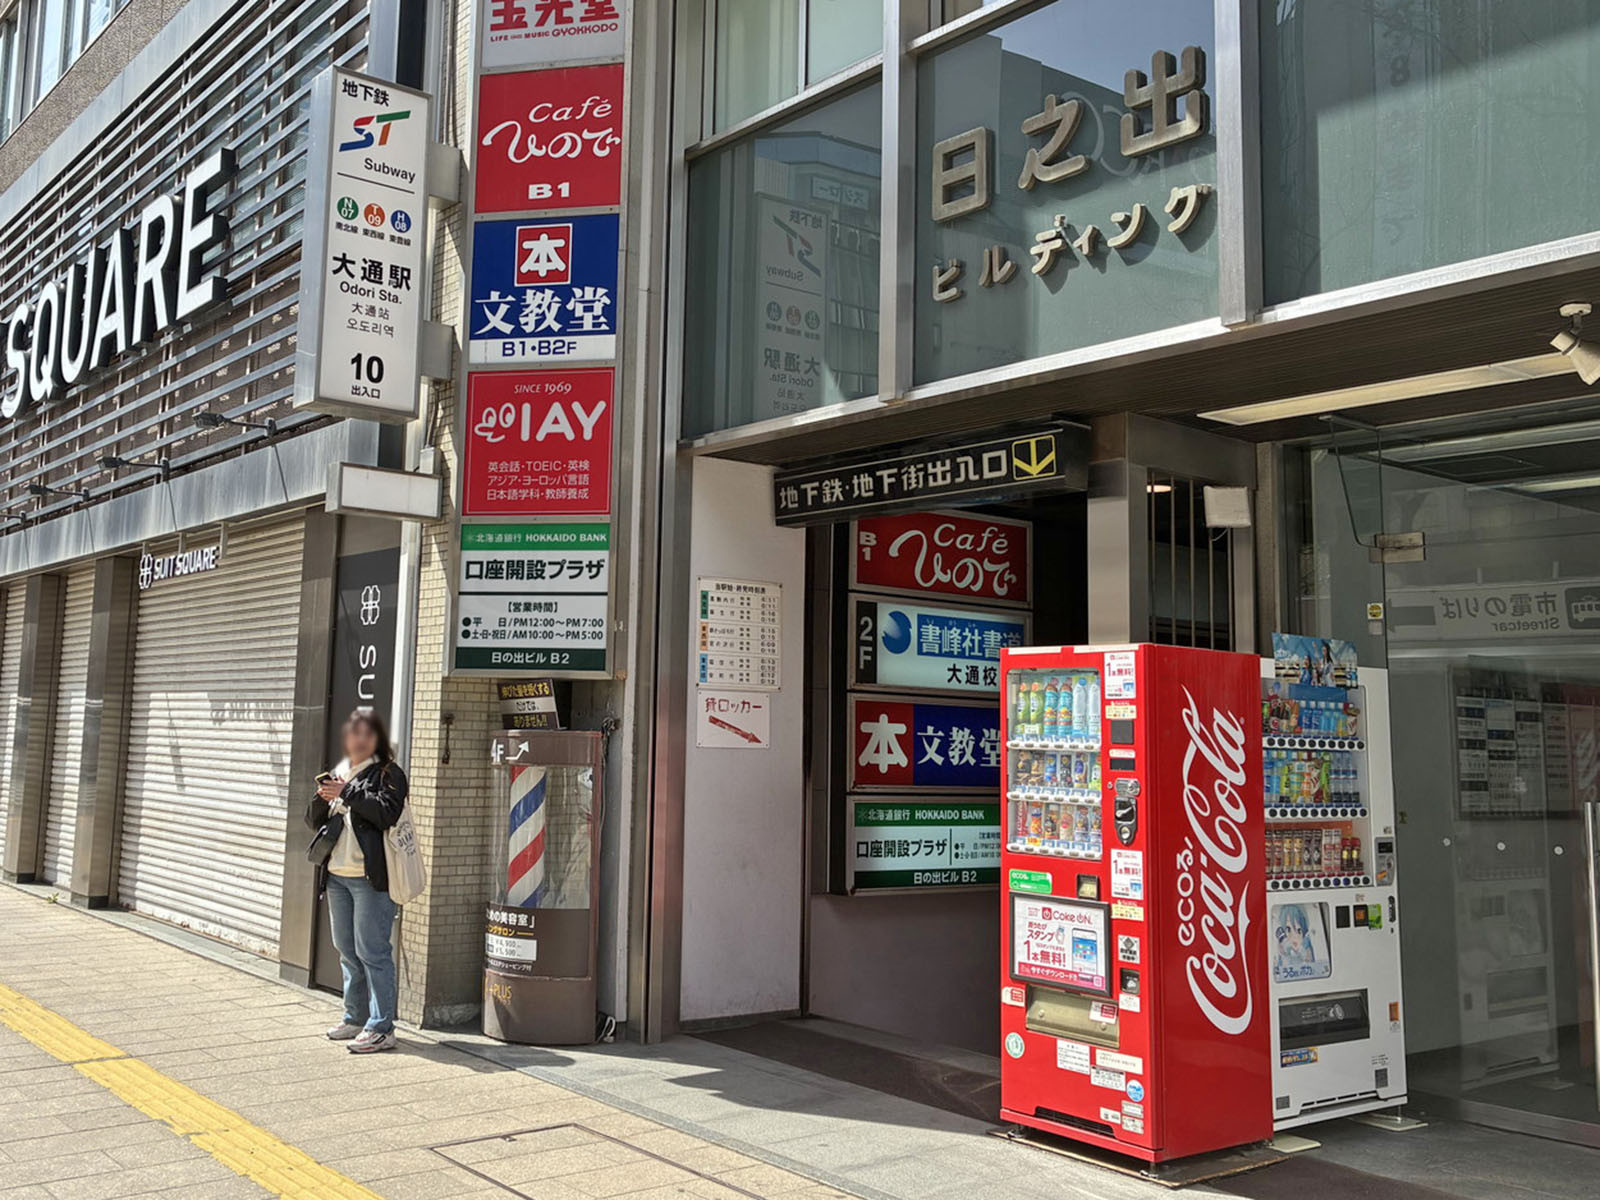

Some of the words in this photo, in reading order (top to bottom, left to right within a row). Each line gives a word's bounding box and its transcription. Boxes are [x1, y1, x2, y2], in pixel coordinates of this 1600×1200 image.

[524, 31, 550, 39] MUSIC
[552, 22, 618, 37] GYOKKODO
[341, 78, 390, 107] 地下鉄
[528, 96, 613, 123] Café
[482, 120, 621, 163] ひので
[932, 46, 1210, 221] 日之出
[364, 157, 416, 184] Subway
[528, 182, 570, 200] B1
[520, 233, 566, 277] 本
[932, 184, 1212, 302] ビルディング
[1, 148, 230, 419] SQUARE
[331, 252, 412, 291] 大通駅
[339, 280, 376, 299] Odori
[378, 287, 403, 305] Sta.
[351, 302, 390, 320] 大通站
[474, 286, 612, 335] 文教堂
[346, 317, 395, 338] 오도리역
[350, 353, 384, 384] 10
[351, 385, 381, 399] 出入口
[514, 383, 541, 394] SINCE
[544, 381, 572, 395] 1969
[780, 450, 1007, 509] 地下鉄・地下街出入口
[476, 533, 522, 543] 北海道銀行
[525, 533, 577, 542] HOKKAIDO
[580, 533, 607, 542] BANK
[933, 523, 1009, 555] Café
[153, 555, 178, 579] SUIT
[175, 546, 218, 575] SQUARE
[465, 558, 606, 581] 口座開設プラザ
[888, 529, 1017, 596] ひので
[508, 601, 559, 613] 【営業時間】
[859, 616, 873, 670] 2F
[491, 652, 547, 664] 日の出ビル
[550, 653, 570, 664] B2
[947, 663, 998, 687] 大通校
[705, 697, 763, 714] 貸ロッカー
[858, 713, 909, 774] 本
[916, 725, 1001, 768] 文教堂
[868, 809, 911, 822] 北海道銀行
[915, 809, 960, 820] HOKKAIDO
[961, 810, 985, 820] BANK
[856, 838, 948, 859] 口座開設プラザ
[1181, 684, 1253, 1035] Coca-Cola
[913, 871, 960, 884] 日の出ビル
[962, 870, 977, 882] B2
[1053, 910, 1076, 923] Coke
[1027, 929, 1056, 942] スタンプ
